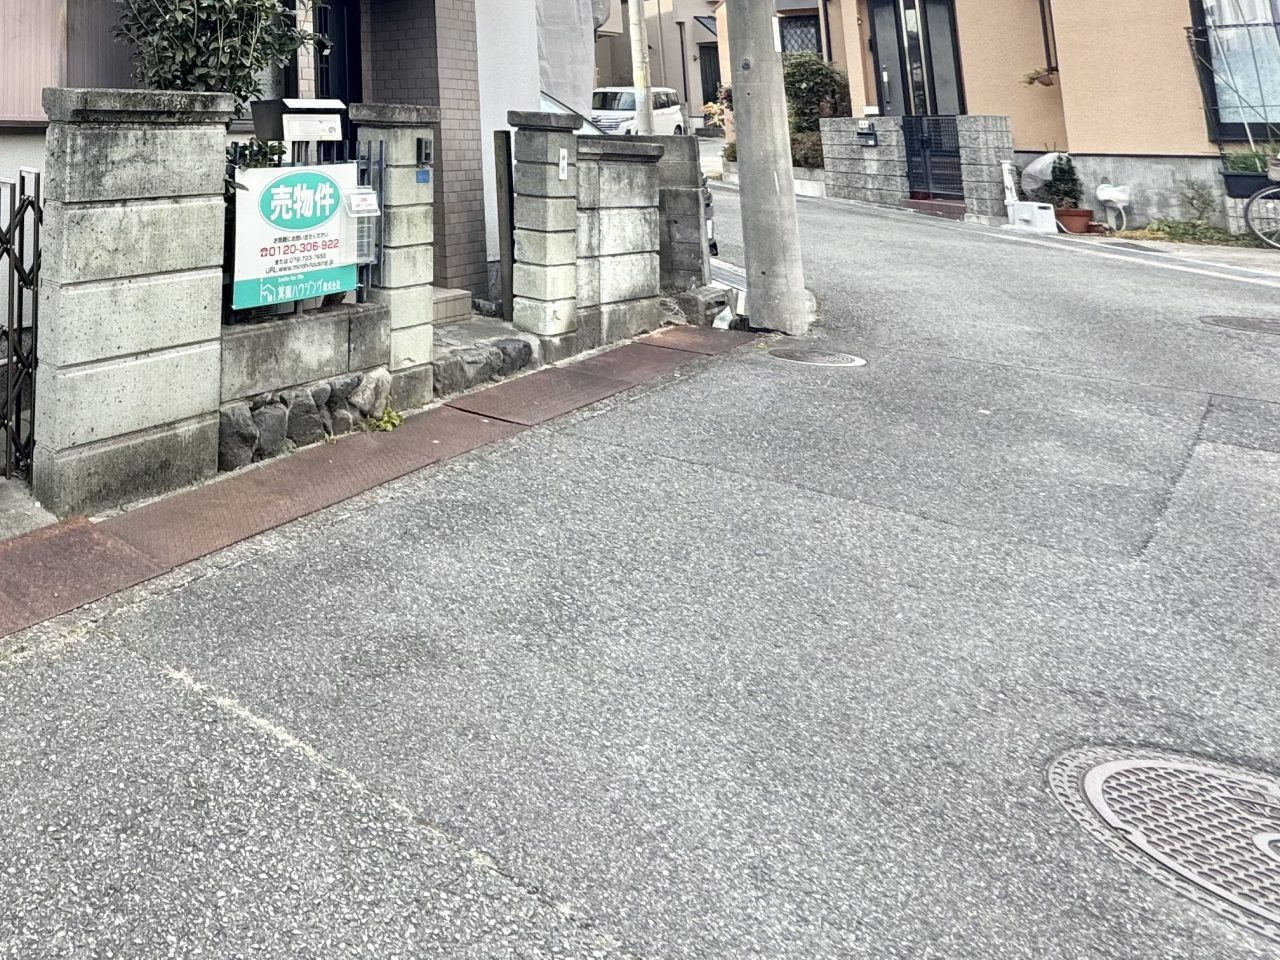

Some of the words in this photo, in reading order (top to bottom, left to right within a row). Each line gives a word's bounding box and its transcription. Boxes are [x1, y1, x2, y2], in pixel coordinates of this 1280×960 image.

[270, 182, 335, 221] 売物件
[269, 239, 339, 256] 0120-306-922
